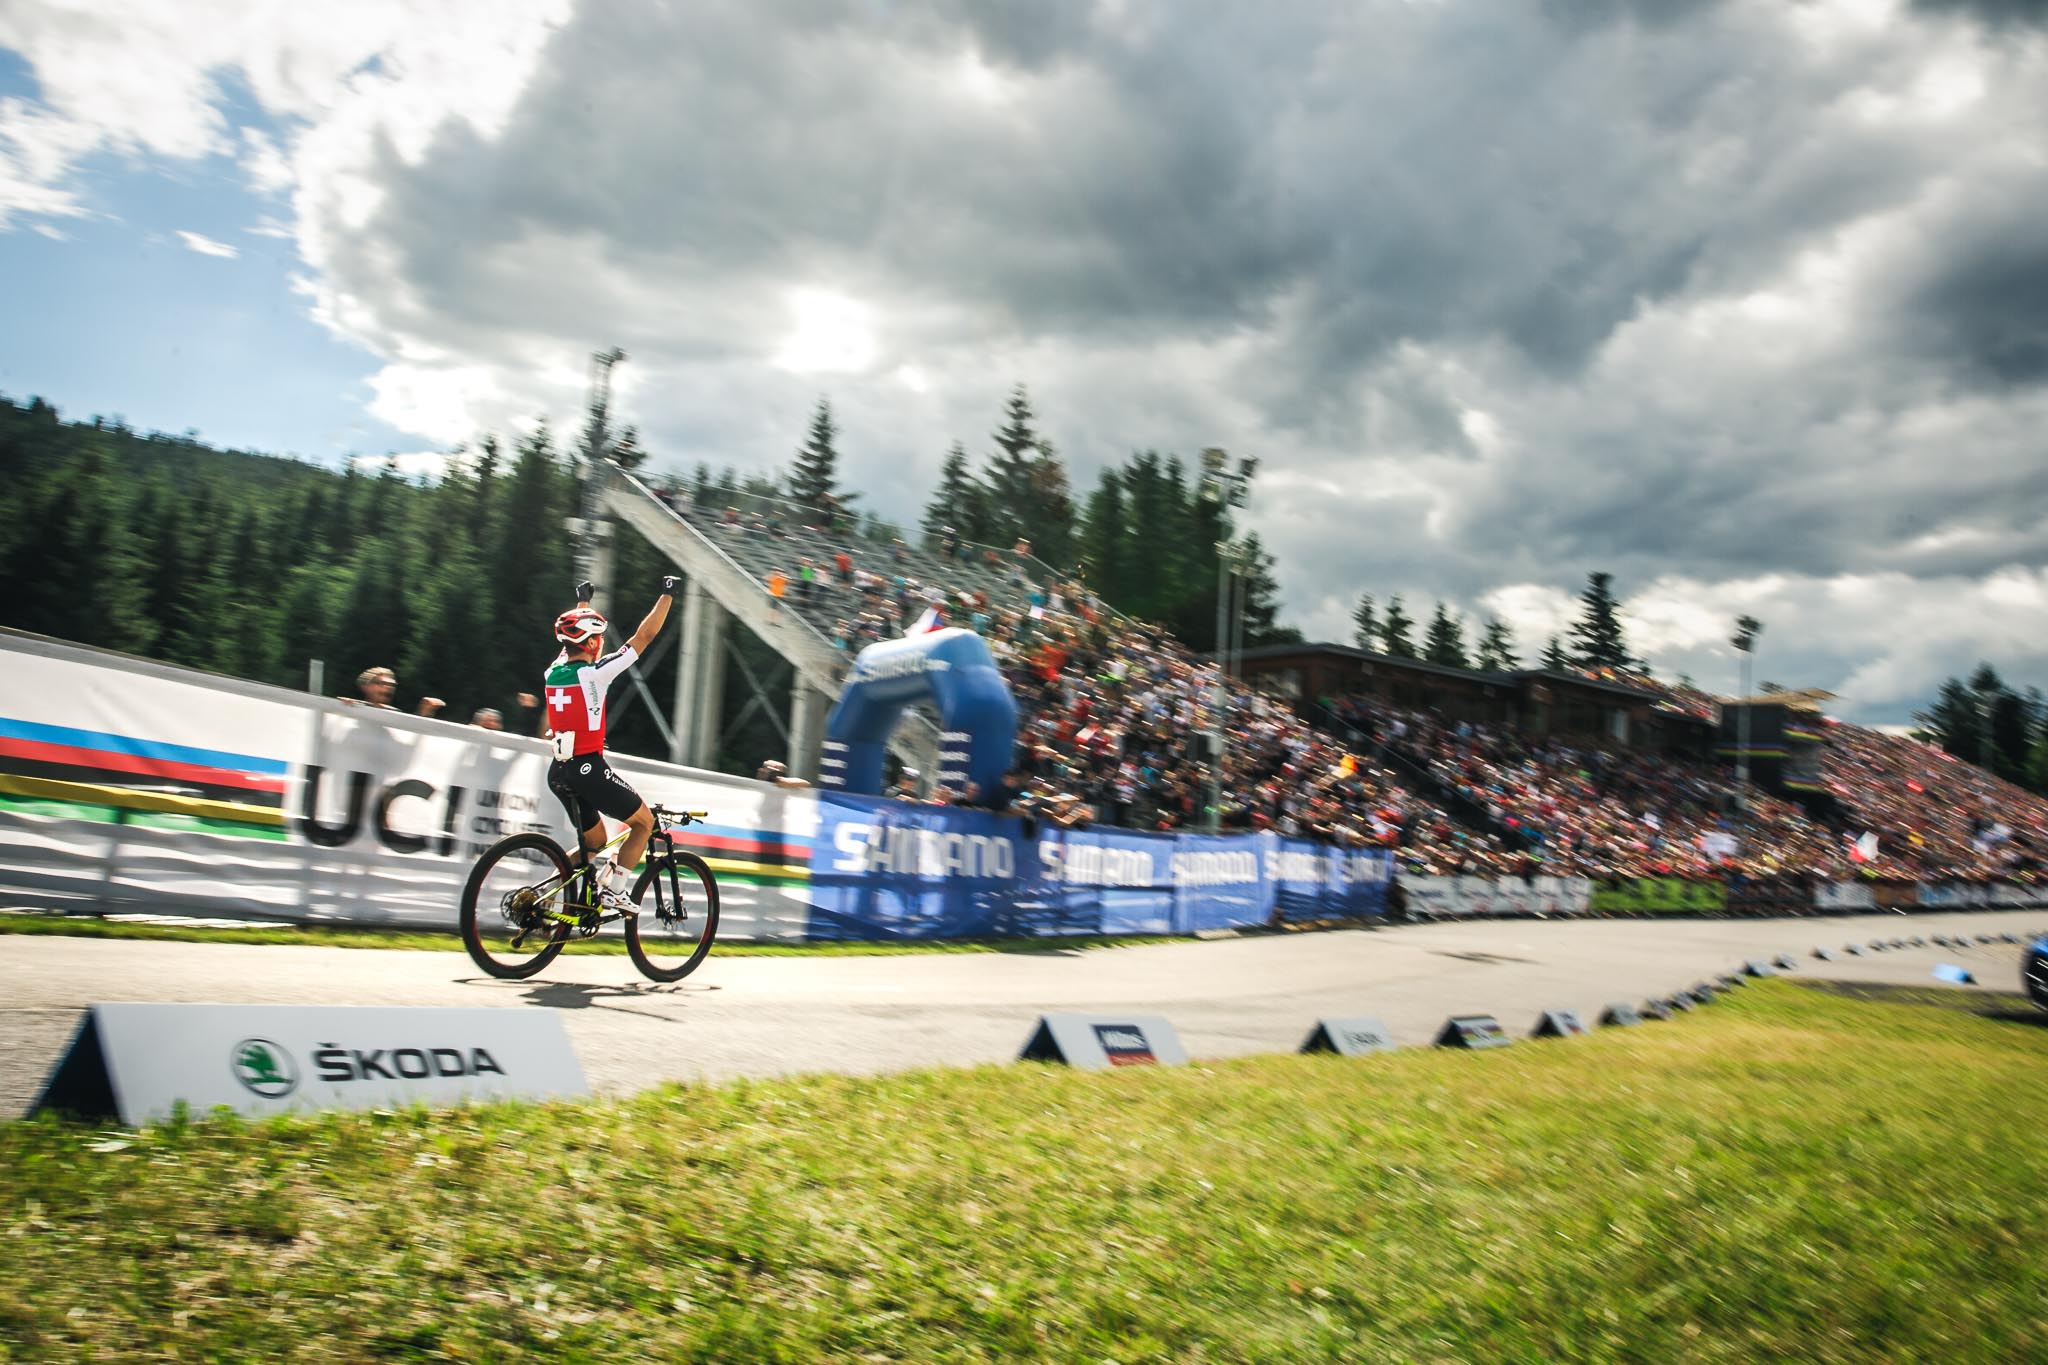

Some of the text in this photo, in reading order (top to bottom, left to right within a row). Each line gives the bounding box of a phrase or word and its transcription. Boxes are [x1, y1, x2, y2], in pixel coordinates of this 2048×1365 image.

[556, 738, 562, 755] 1
[296, 764, 468, 857] UCI
[832, 821, 1015, 880] SHIMANO
[311, 1042, 508, 1082] ŠKODA
